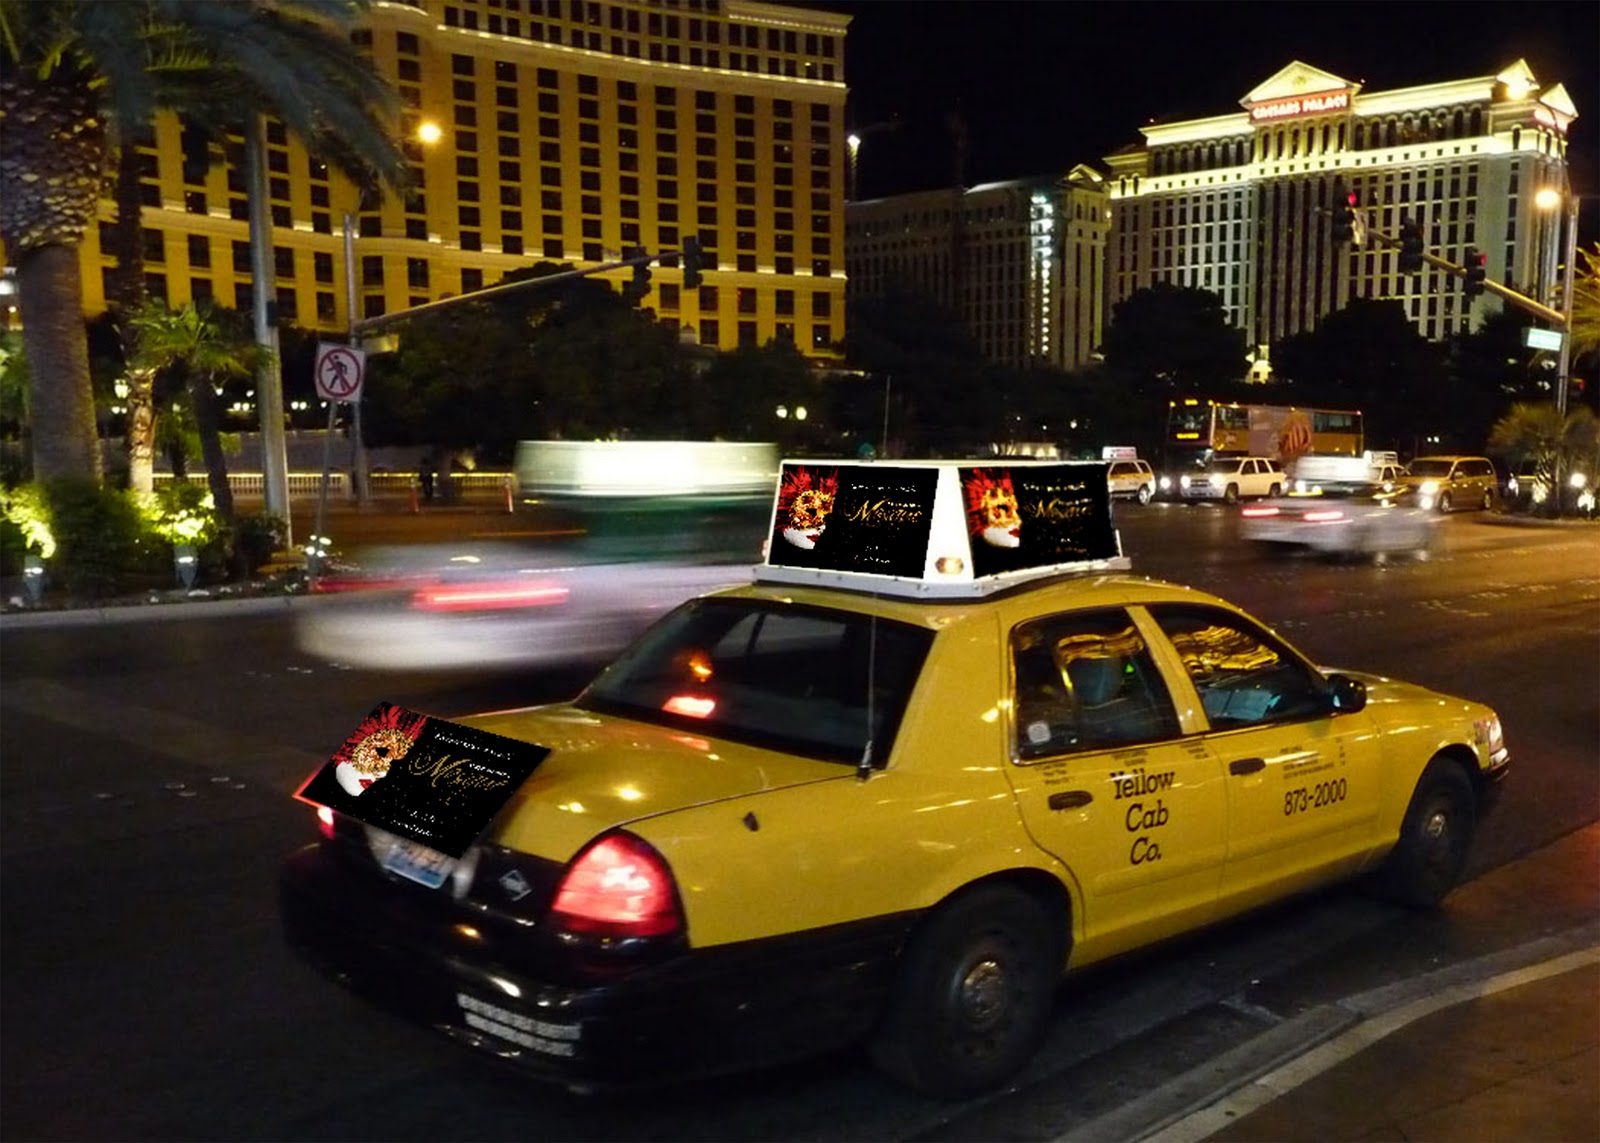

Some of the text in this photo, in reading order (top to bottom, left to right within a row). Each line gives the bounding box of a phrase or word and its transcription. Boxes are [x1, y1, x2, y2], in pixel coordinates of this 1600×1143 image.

[1109, 768, 1175, 800] Yellow
[1284, 778, 1347, 816] 873-2000
[1126, 799, 1169, 832] Cab
[1130, 837, 1161, 865] Co.
